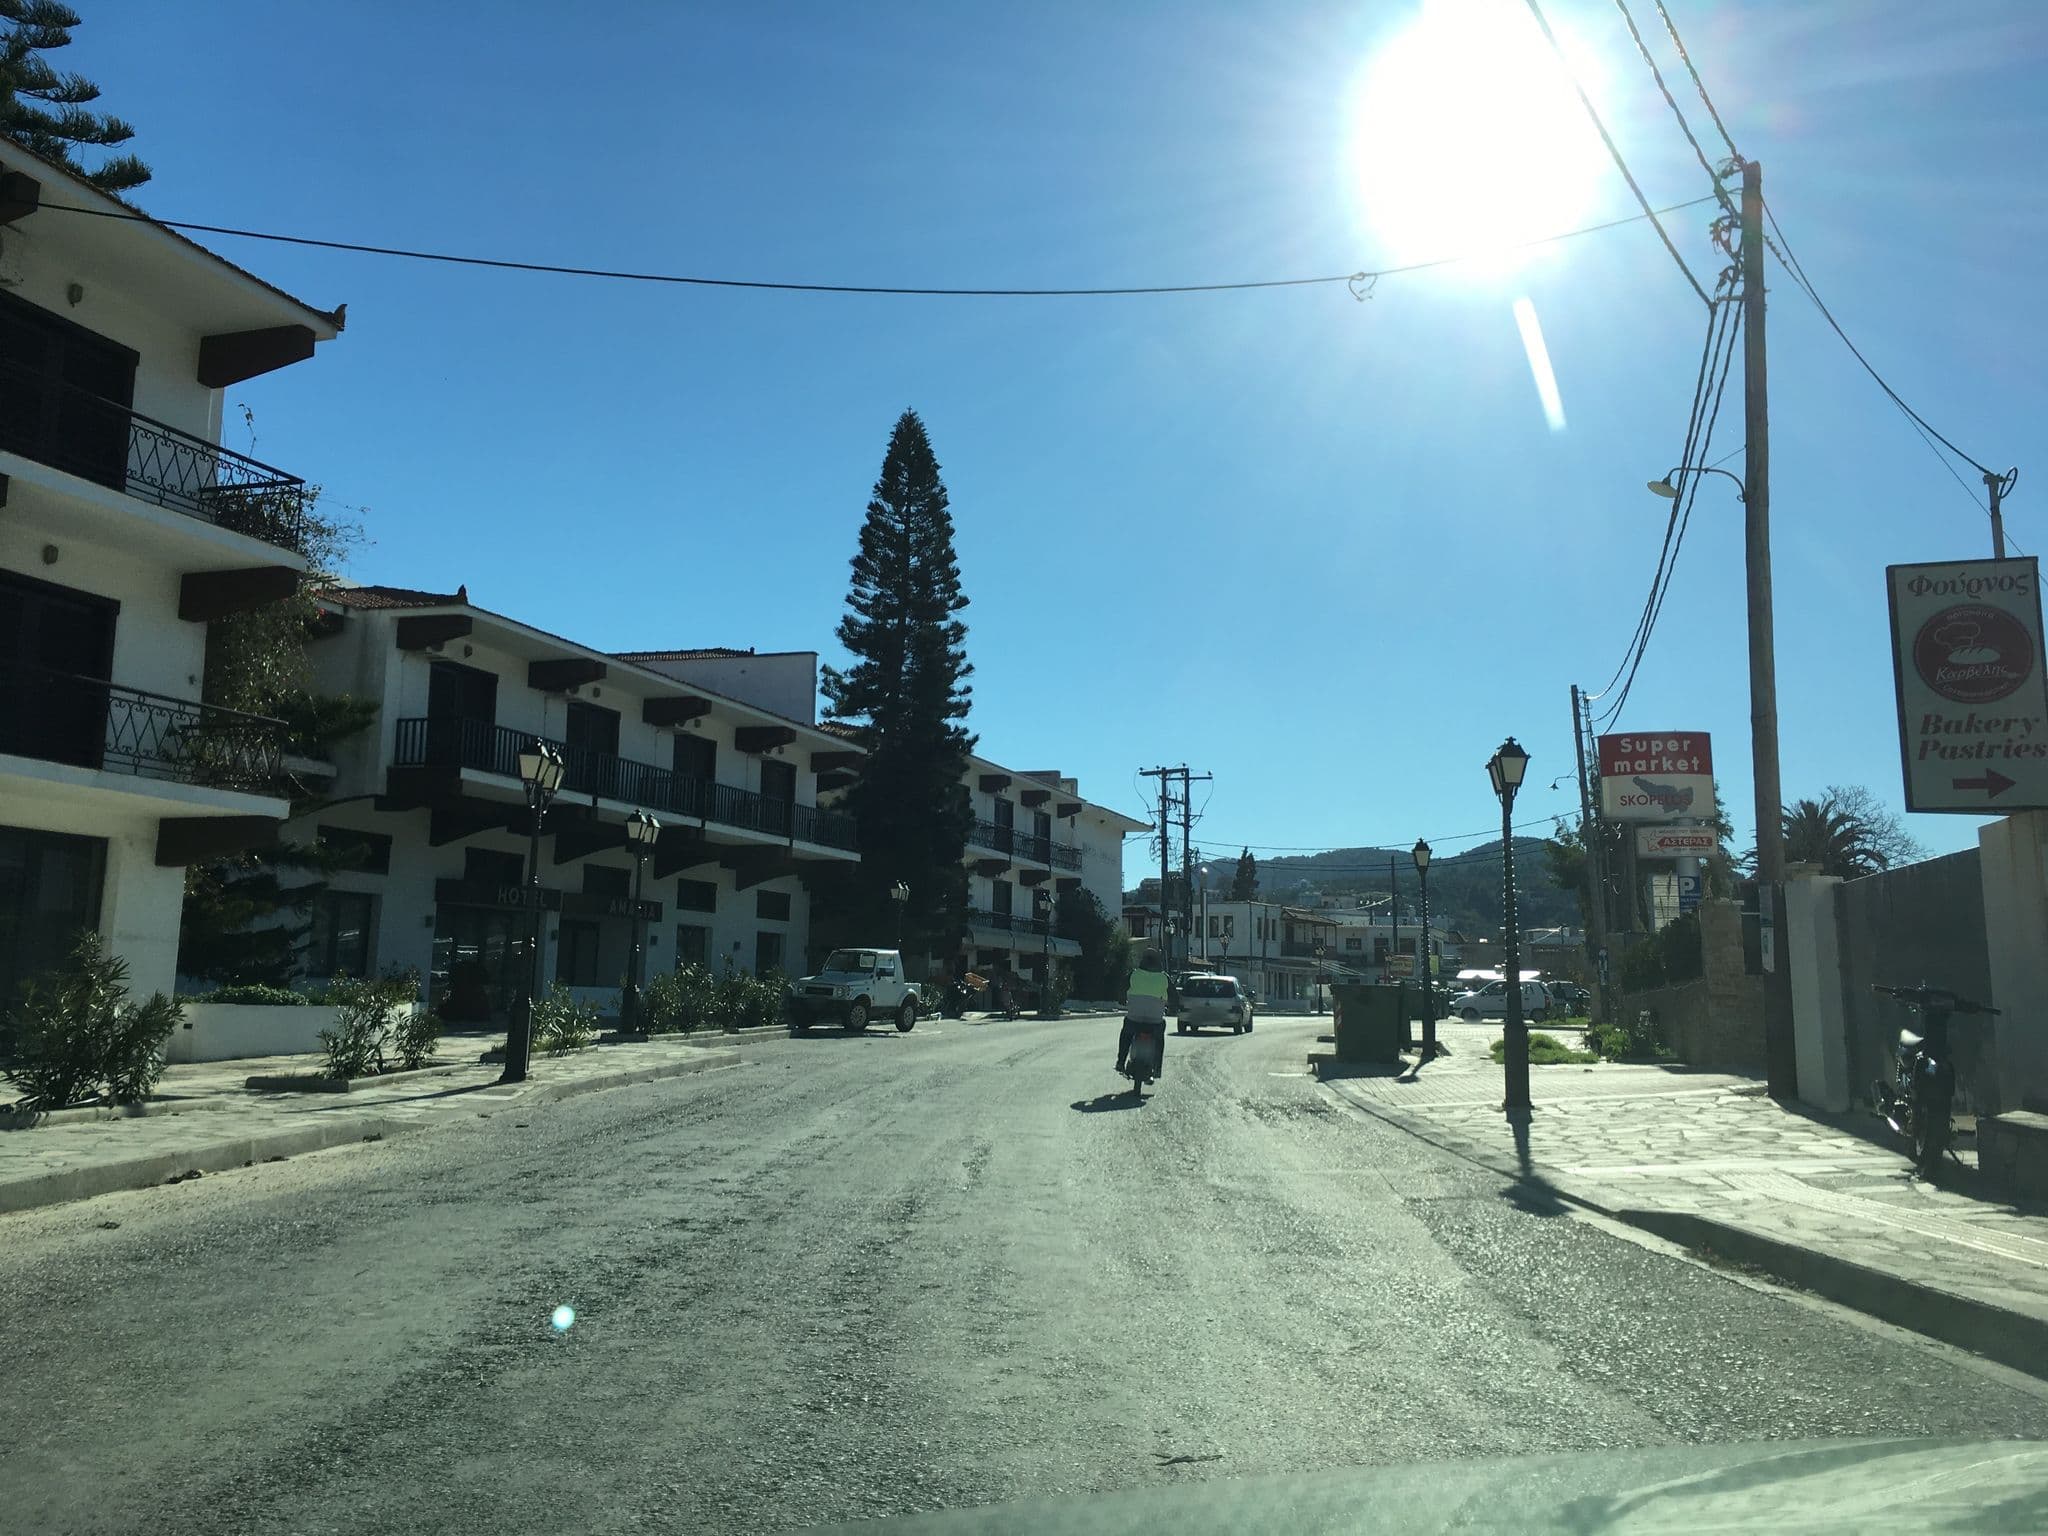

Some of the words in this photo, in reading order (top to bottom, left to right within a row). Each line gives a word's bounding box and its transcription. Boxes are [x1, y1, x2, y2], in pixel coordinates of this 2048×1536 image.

[1907, 571, 2031, 600] Φούρνος
[1919, 712, 2041, 739] Bakery
[1620, 737, 1691, 756] Super
[1918, 737, 2048, 761] Pastries
[1614, 756, 1700, 773] market
[1663, 837, 1709, 846] ΑΣΤΕΡΑΣ
[1680, 877, 1695, 896] P
[497, 887, 547, 907] HOTL
